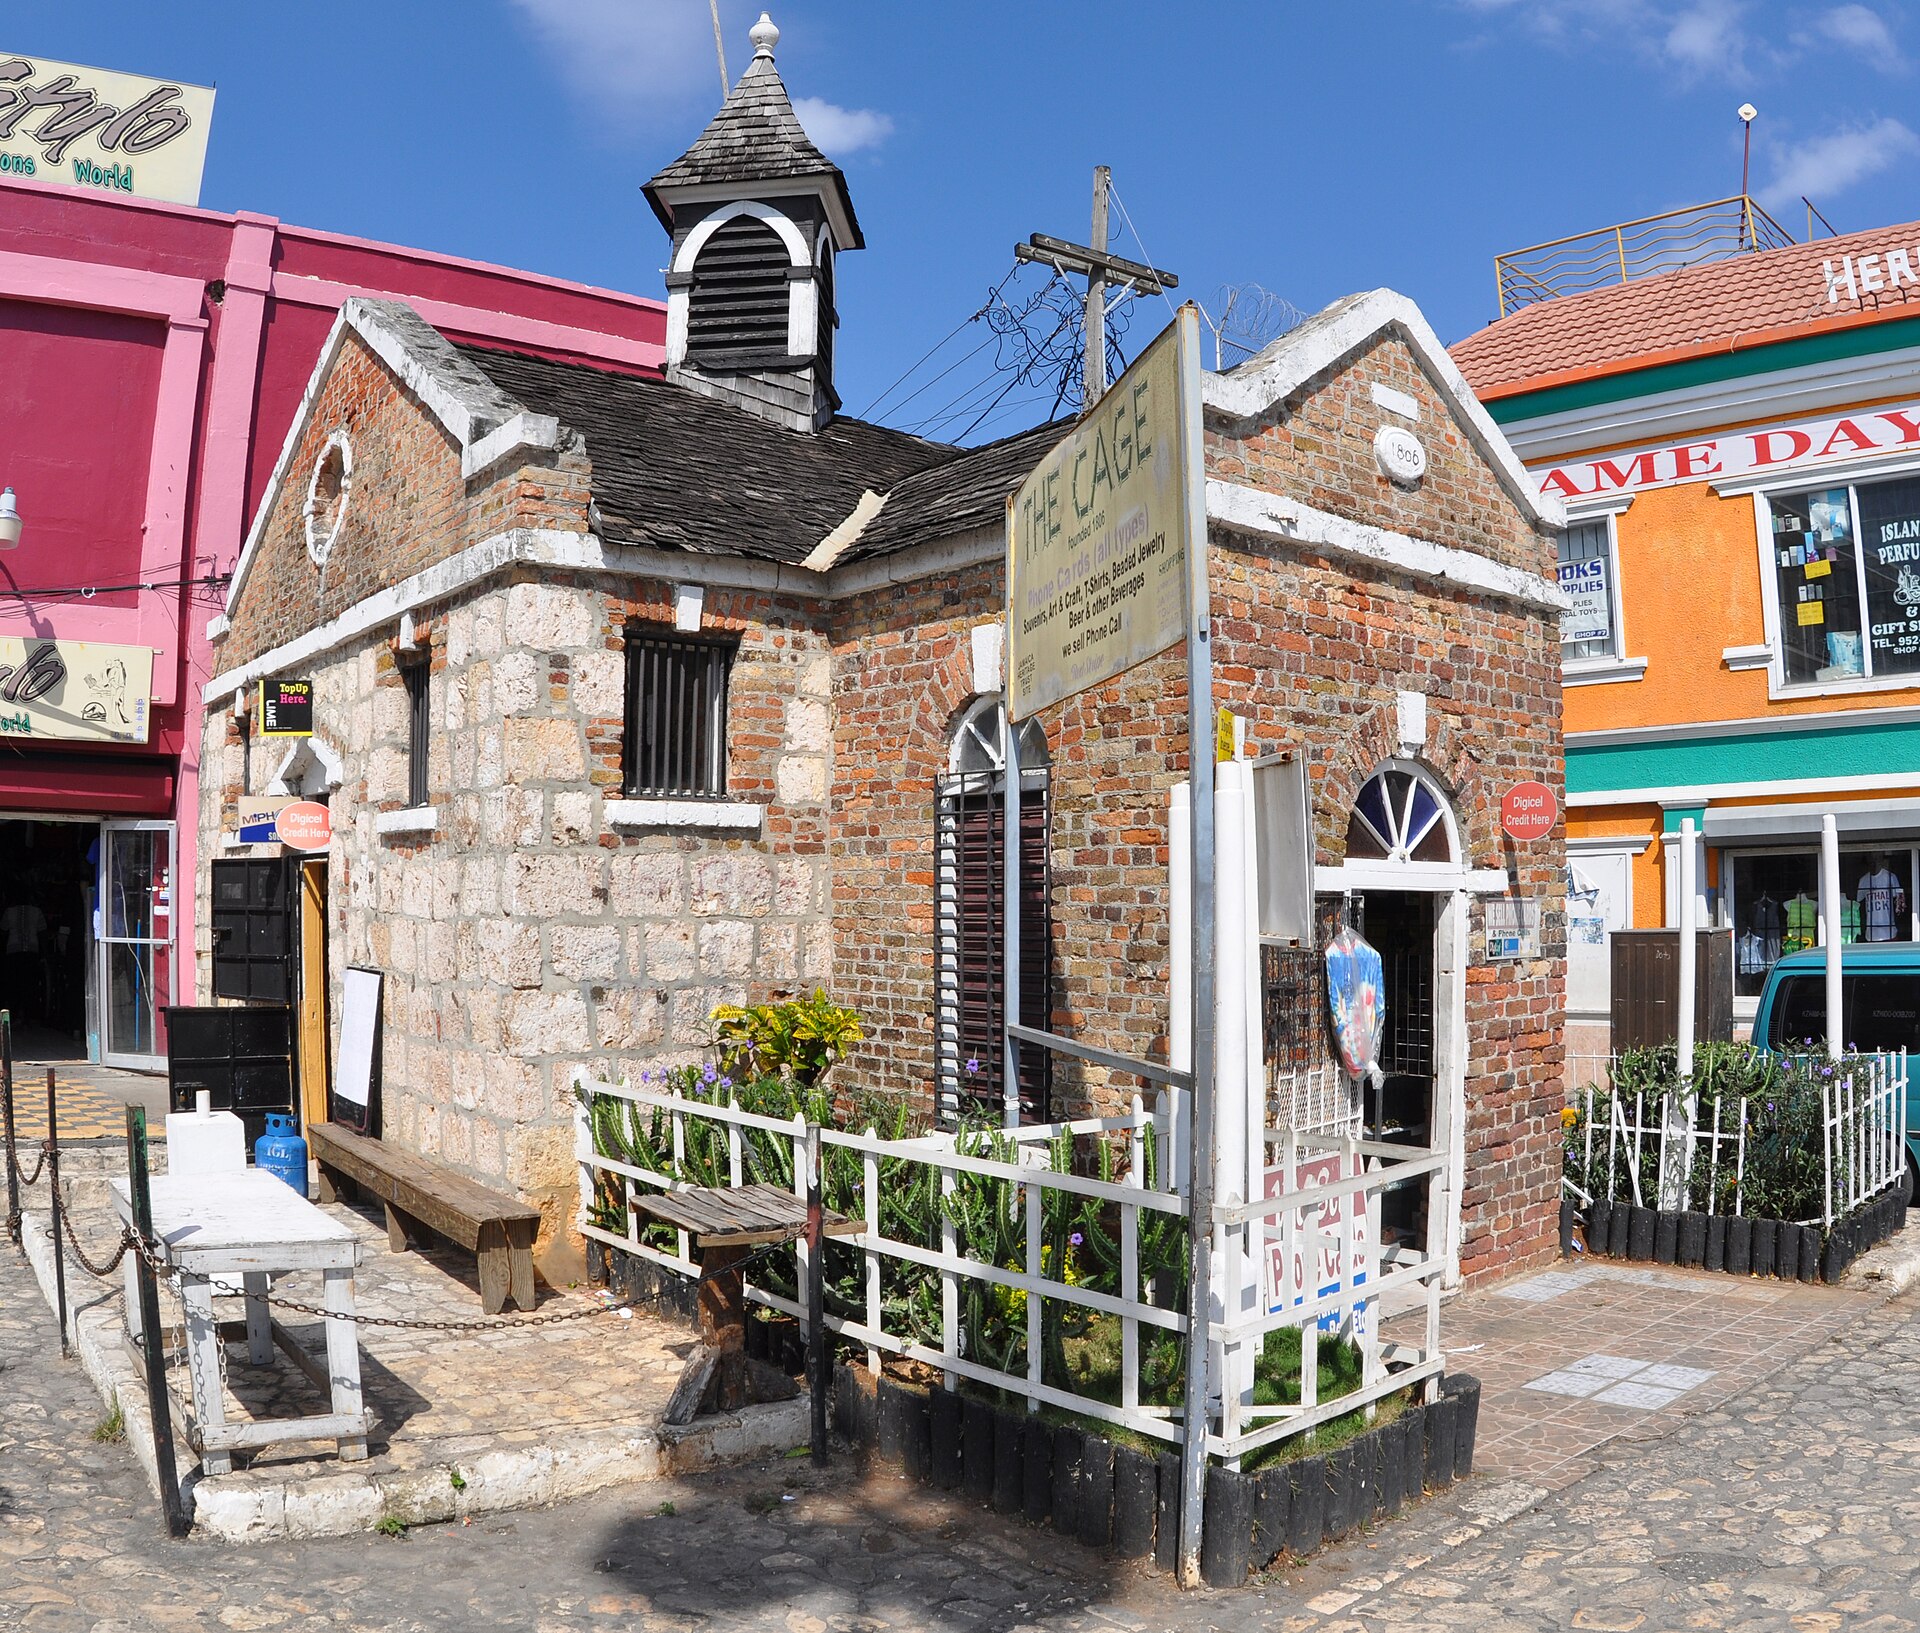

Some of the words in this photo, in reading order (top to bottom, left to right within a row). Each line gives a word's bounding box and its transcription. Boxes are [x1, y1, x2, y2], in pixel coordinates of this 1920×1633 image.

[0, 154, 36, 175] ons
[72, 158, 134, 192] World
[1822, 246, 1920, 304] HER
[1391, 441, 1420, 466] 1806
[1539, 441, 1723, 498] AME
[1745, 410, 1920, 468] DAY
[1024, 466, 1063, 564] THE
[1072, 379, 1153, 520] CAGE
[1067, 521, 1091, 551] founded
[1880, 520, 1920, 542] ISLAN
[1027, 578, 1054, 612] Phone
[1057, 551, 1091, 592] Cards
[1094, 530, 1111, 571] (all
[1114, 503, 1149, 555] types)
[1878, 542, 1920, 565] PERFU
[1049, 600, 1058, 620] Art
[1065, 585, 1083, 609] Craft,
[1084, 570, 1111, 598] T-Shirts,
[1112, 547, 1137, 582] Beaded
[1138, 531, 1165, 564] Jewelry
[1555, 560, 1603, 583] OKS
[1562, 579, 1603, 595] PPLIES
[1068, 609, 1084, 630] Beer
[1092, 594, 1109, 617] other
[1110, 571, 1145, 606] Beverages
[1572, 598, 1593, 608] PLIES
[1579, 607, 1598, 616] TOYS
[1905, 606, 1918, 618] &
[1062, 643, 1071, 658] we
[1073, 631, 1085, 653] sell
[1086, 624, 1108, 647] Phone
[1109, 611, 1122, 635] Call
[1575, 630, 1596, 639] SHOP
[1872, 621, 1906, 636] GIFT
[1873, 638, 1896, 649] TEL.
[1898, 635, 1920, 646] 952-
[1893, 645, 1917, 654] SHOP
[279, 683, 309, 694] TopUp
[280, 694, 307, 704] Here.
[0, 712, 31, 733] orld
[266, 699, 276, 727] LIME
[1513, 796, 1543, 811] Digicel
[290, 813, 322, 826] Digicel
[1506, 814, 1529, 826] Credit
[1531, 814, 1550, 825] Here
[282, 827, 308, 838] Credit
[310, 828, 330, 838] Here
